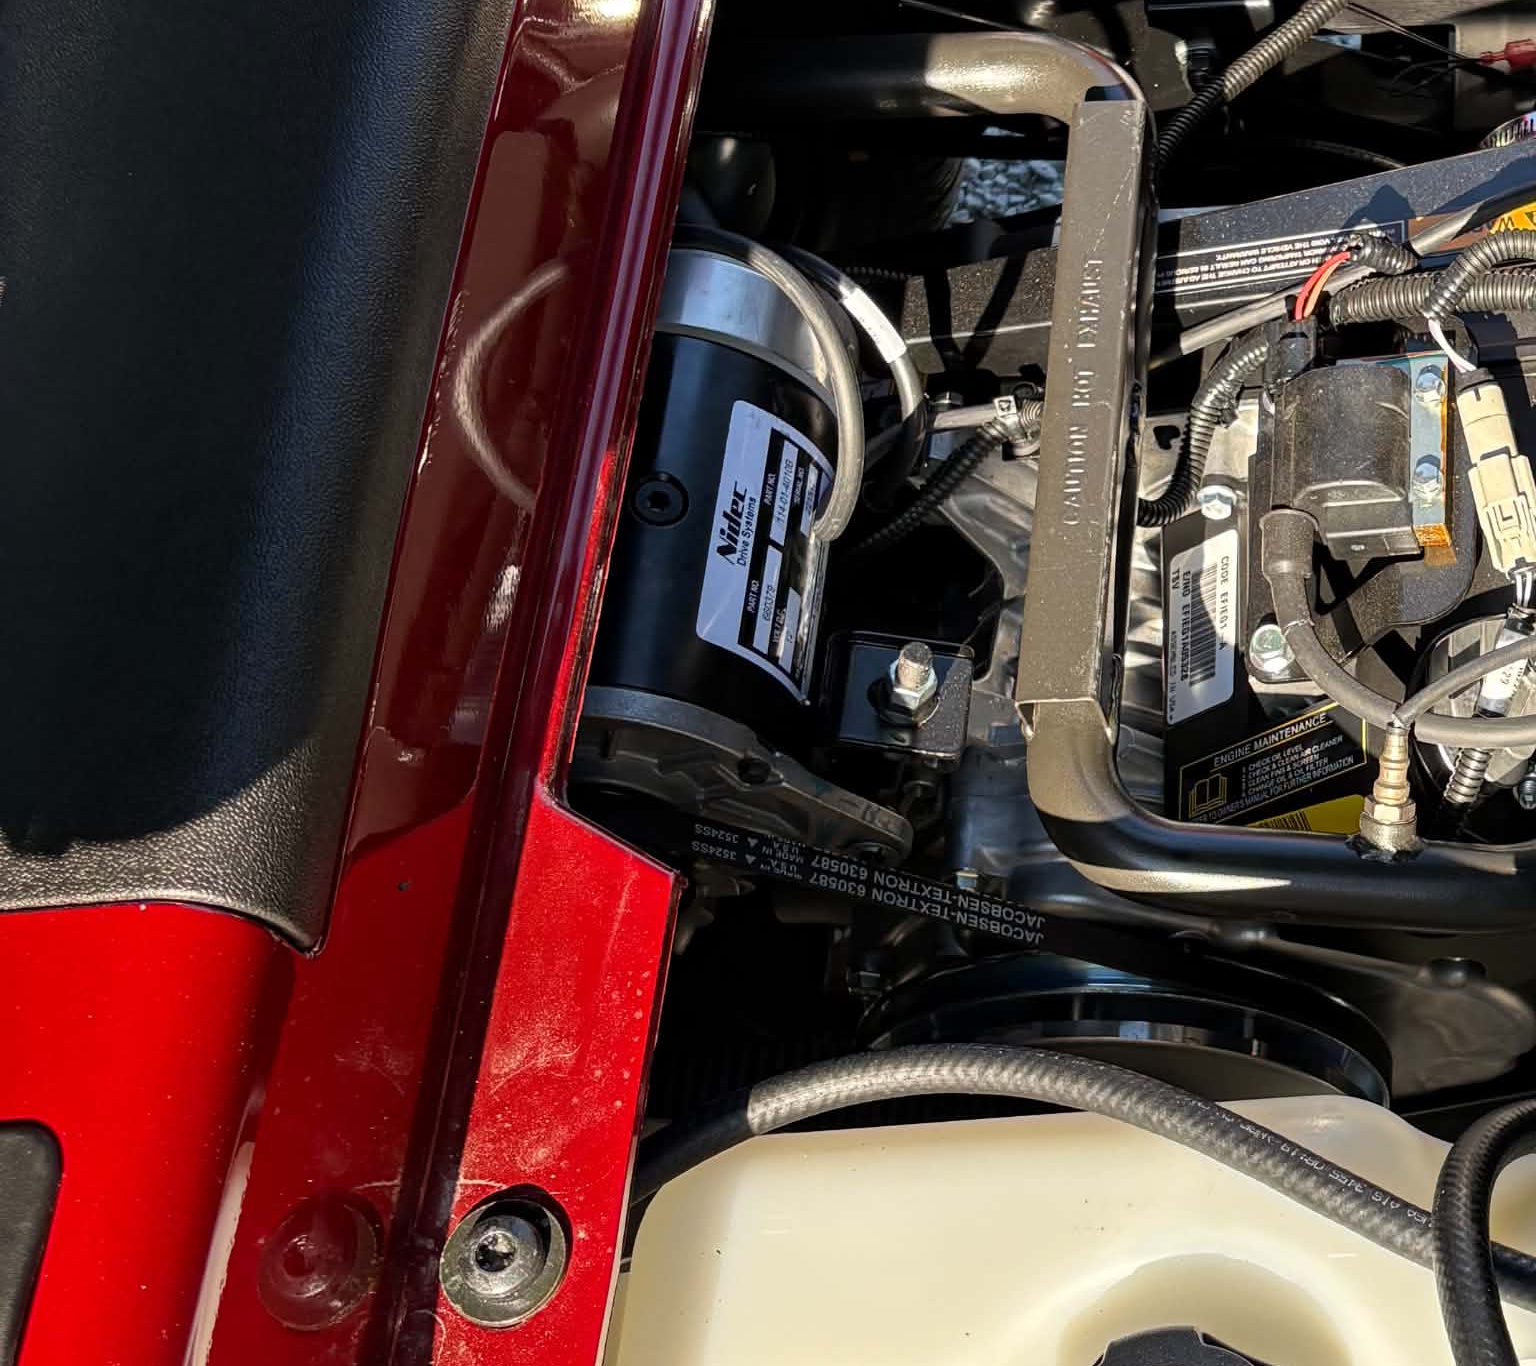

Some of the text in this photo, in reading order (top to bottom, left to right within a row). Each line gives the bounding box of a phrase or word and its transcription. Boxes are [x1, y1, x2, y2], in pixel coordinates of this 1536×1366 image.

[1062, 256, 1103, 526] CAUTION HOT EXHAUST
[714, 479, 748, 564] Nidec
[736, 497, 757, 566] Drive Systems
[1220, 556, 1229, 586] CODE
[1212, 713, 1328, 767] ENGINE MAINTENANCE
[808, 870, 867, 897] 630587
[810, 853, 869, 880] 630587
[870, 885, 1045, 947] JACOBSEN-TEXTRON
[871, 868, 1047, 931] JACOBSEN-TEXTRON
